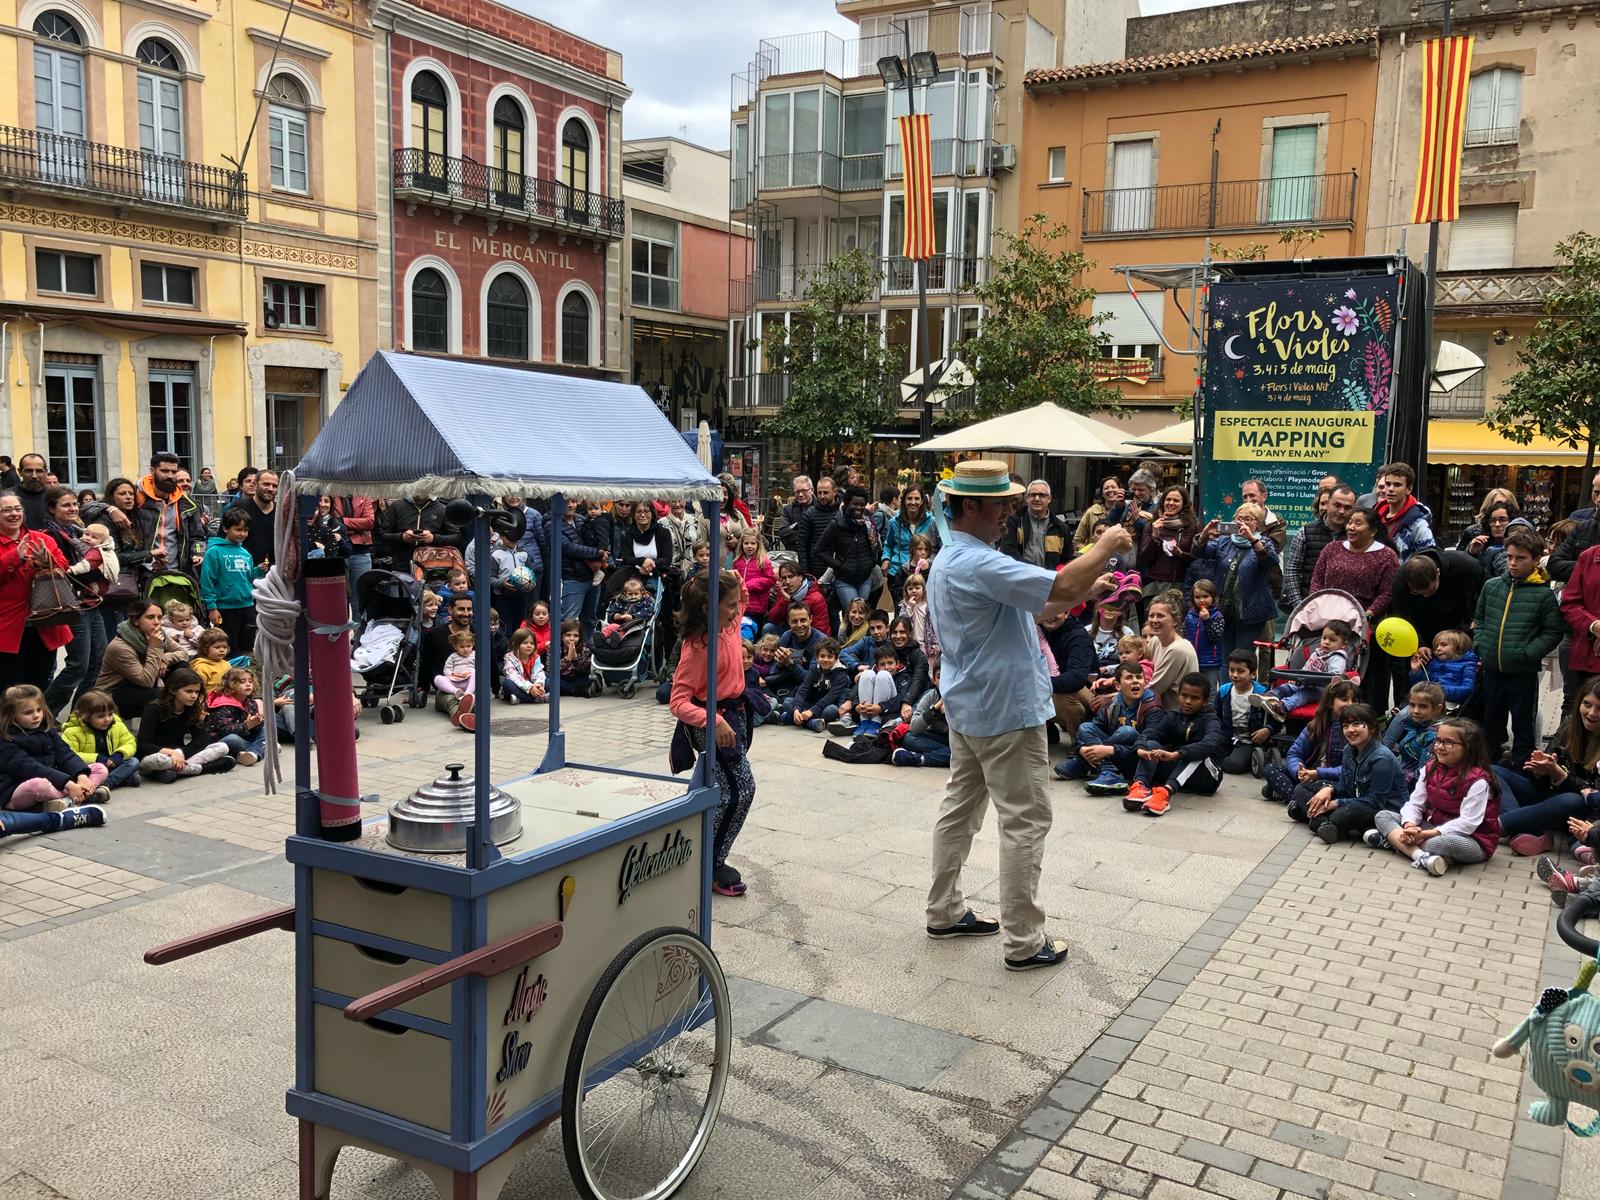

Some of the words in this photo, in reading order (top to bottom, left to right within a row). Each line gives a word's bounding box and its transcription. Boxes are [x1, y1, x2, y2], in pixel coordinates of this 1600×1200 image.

[435, 230, 461, 250] EL
[472, 236, 575, 270] MERCANTIL
[1245, 301, 1323, 340] Flors
[1257, 339, 1268, 354] i
[1272, 327, 1350, 361] Violes
[1280, 363, 1288, 375] 5
[1290, 362, 1304, 375] de
[1304, 361, 1336, 383] maig
[1266, 383, 1288, 392] Flors
[1293, 382, 1314, 392] Violes
[1315, 382, 1329, 392] Nit
[1283, 394, 1292, 402] de
[1293, 394, 1312, 405] maig
[1220, 417, 1292, 427] ESPECTACLE
[1295, 417, 1368, 427] INAUGURAL
[1238, 431, 1345, 448] MAPPING
[1288, 450, 1301, 458] EN
[1249, 468, 1272, 476] Disseny
[1288, 476, 1321, 484] Playmode
[504, 965, 549, 1026] Magic
[496, 1030, 534, 1084] Show
